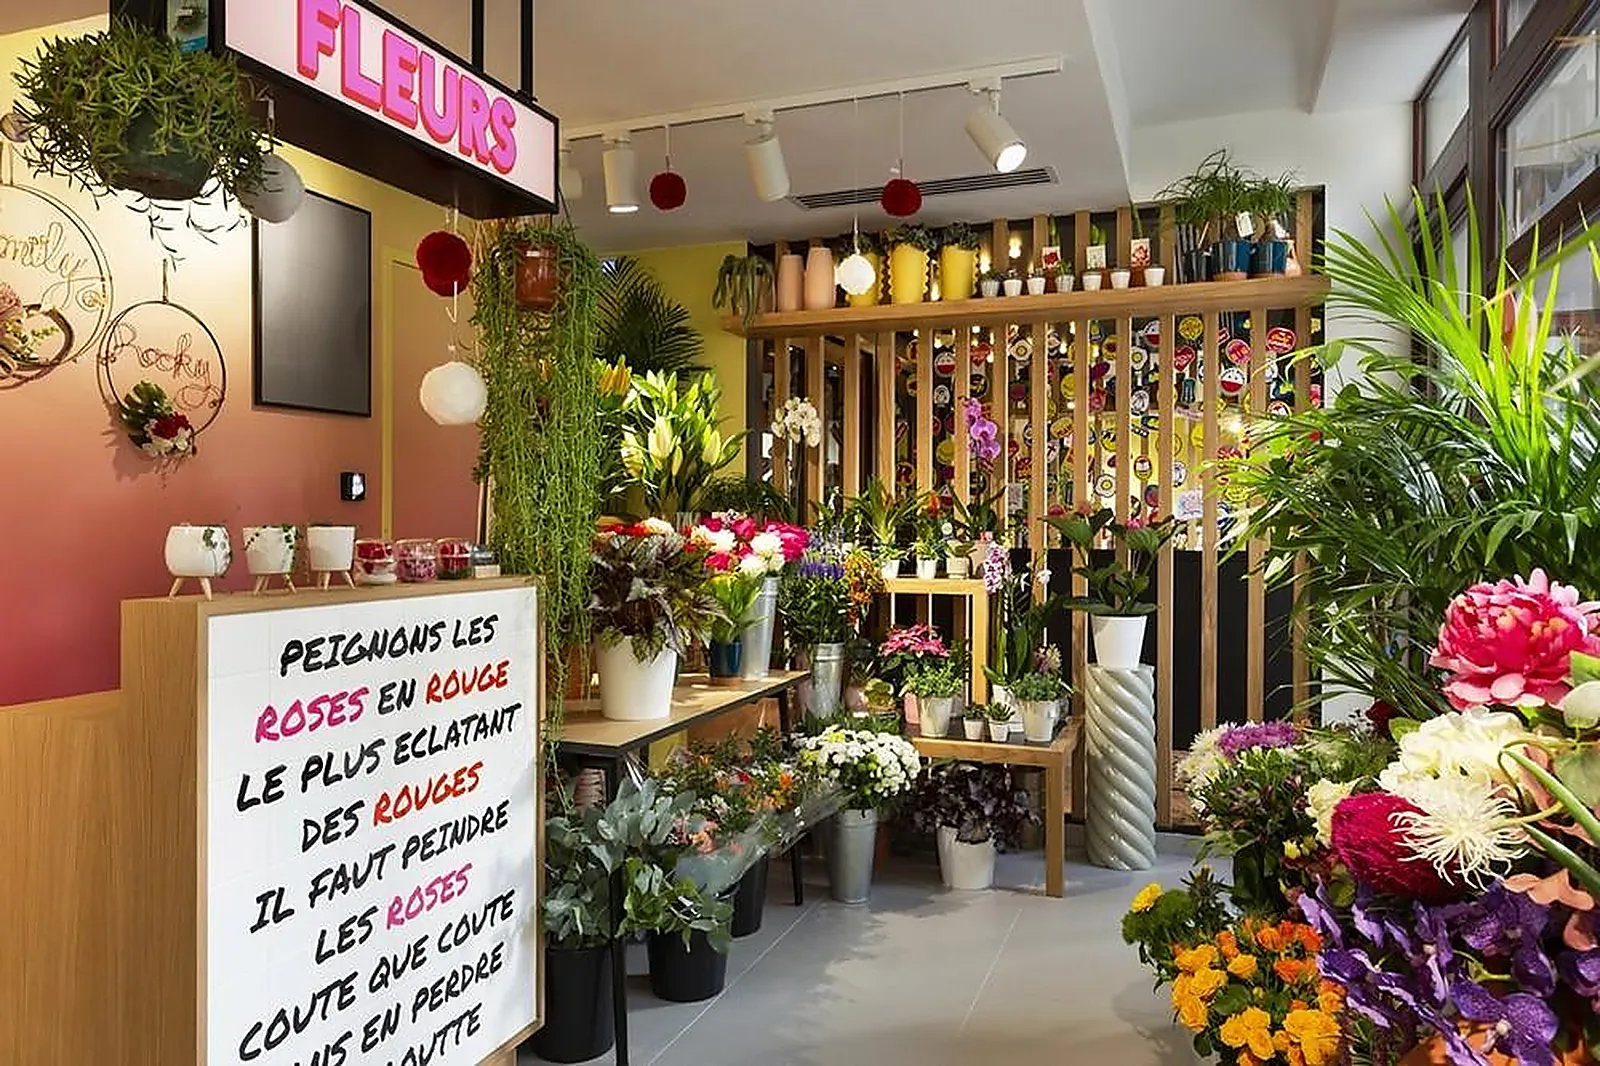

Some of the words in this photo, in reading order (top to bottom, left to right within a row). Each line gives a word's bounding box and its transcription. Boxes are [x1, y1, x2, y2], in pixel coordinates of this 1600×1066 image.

[297, 0, 517, 174] FLEURS
[280, 621, 446, 677] PEIGNONS
[452, 615, 498, 648] LES
[256, 687, 369, 743] ROSES
[378, 679, 416, 715] EN
[426, 660, 510, 704] ROUGE
[237, 765, 287, 812] LE
[301, 739, 385, 793] PLUS
[394, 703, 522, 765] ECLATANT
[302, 800, 365, 852] DES
[374, 761, 484, 826] ROUGES
[250, 887, 294, 933] IL
[309, 844, 396, 908] FAUT
[402, 800, 509, 869] PEINDRE
[315, 906, 378, 964] LES
[386, 863, 472, 930] ROSES
[239, 971, 358, 1061] COUTE
[369, 935, 429, 993] QUE
[438, 889, 515, 953] COUTE
[361, 1003, 401, 1053] EN
[412, 942, 504, 1023] PERDRE
[387, 1003, 482, 1066] OUTTE
